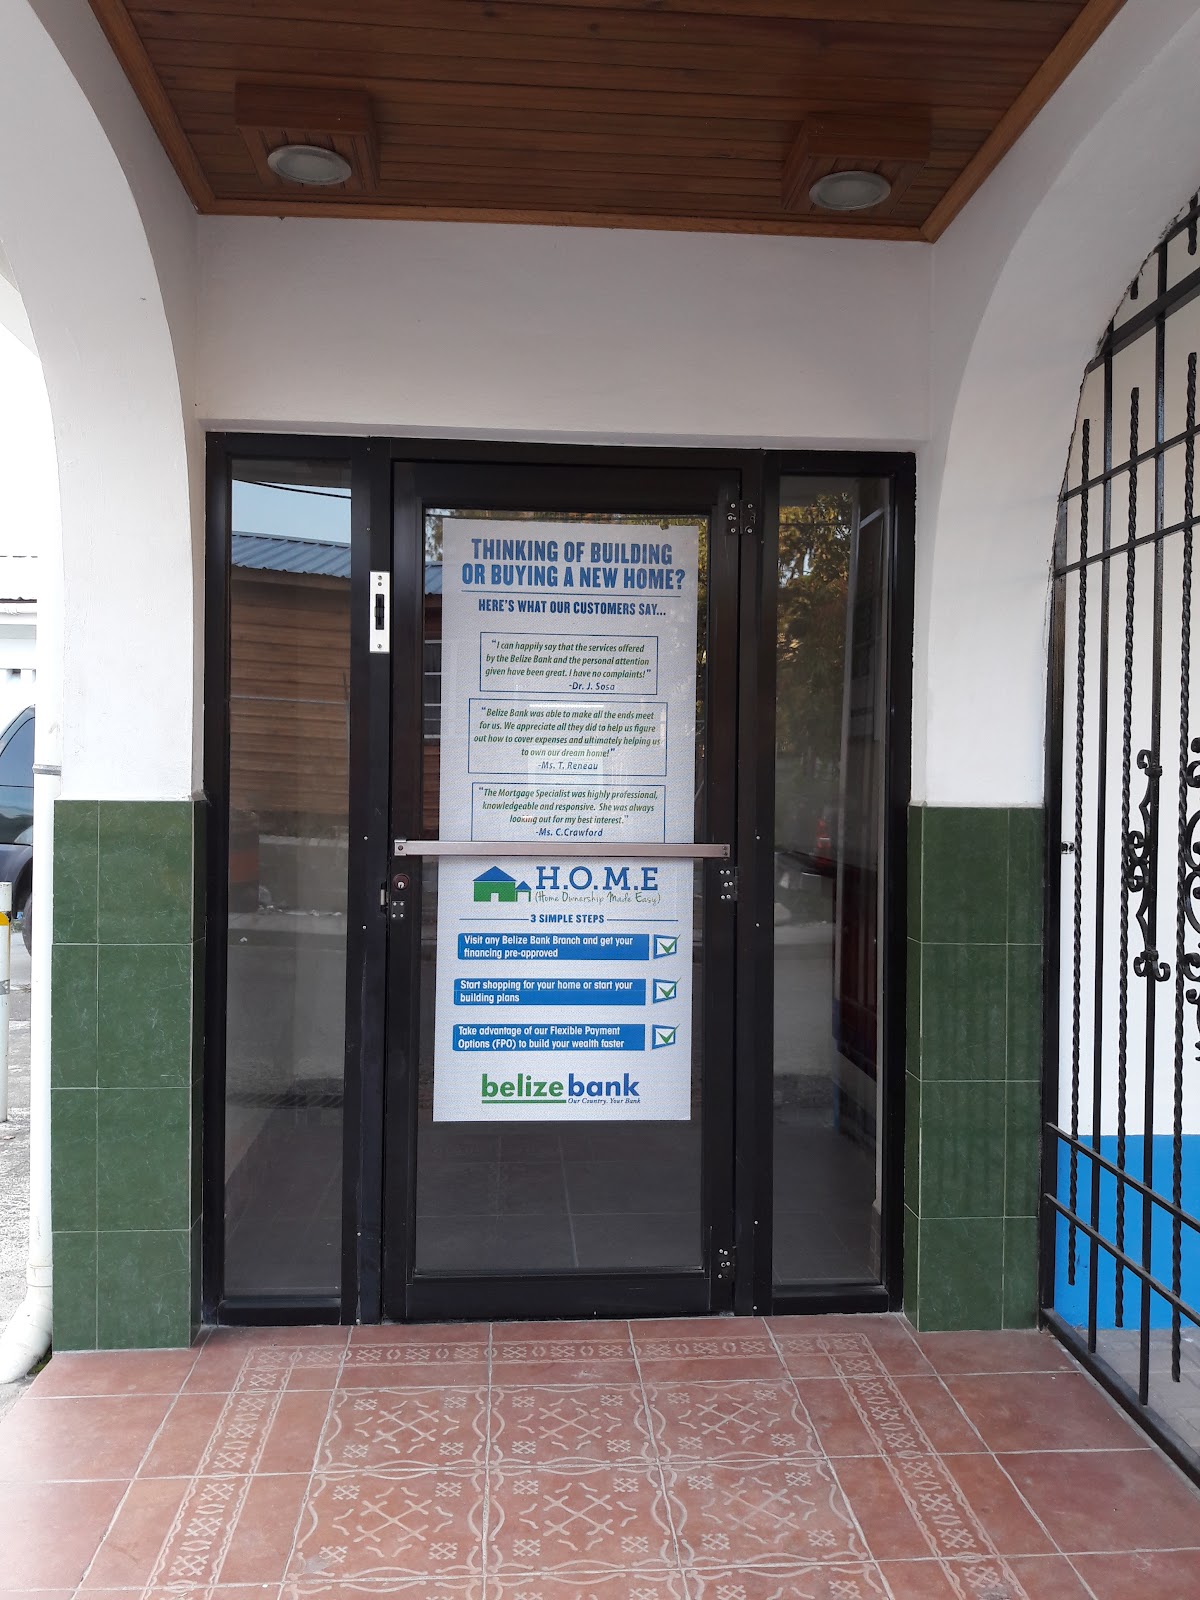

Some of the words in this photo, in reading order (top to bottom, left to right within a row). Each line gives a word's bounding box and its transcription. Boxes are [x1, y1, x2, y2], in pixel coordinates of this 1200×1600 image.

[472, 539, 558, 562] THINKING
[564, 541, 585, 562] OF
[591, 543, 672, 564] BUILDING
[462, 563, 485, 584] OR
[491, 564, 558, 586] BUYING
[564, 566, 574, 587] A
[580, 567, 618, 588] NEW
[624, 568, 685, 589] HOME?
[478, 599, 514, 611] HERE'S
[518, 600, 547, 613] WHAT
[550, 601, 570, 613] OUR
[574, 602, 635, 615] CUSTOMERS
[515, 642, 543, 652] happily
[544, 645, 556, 653] say
[618, 644, 644, 652] offered
[486, 654, 495, 663] by
[510, 655, 532, 663] Belize
[533, 655, 552, 663] Bank
[569, 656, 581, 664] the
[582, 657, 614, 666] personal
[485, 667, 505, 677] given
[526, 668, 544, 676] been
[546, 669, 567, 678] great.
[569, 682, 584, 690] -Dr.
[572, 710, 592, 718] make
[593, 710, 603, 718] all
[604, 710, 616, 719] the
[479, 721, 490, 731] for
[517, 722, 555, 733] appreciate
[568, 723, 584, 733] they
[607, 724, 623, 734] help
[634, 724, 656, 734] figure
[584, 736, 622, 746] ultimately
[623, 737, 650, 746] helping
[561, 749, 585, 757] dream
[538, 761, 555, 769] -Ms.
[498, 789, 534, 799] Mortgage
[536, 790, 570, 800] Specialist
[587, 790, 610, 800] highly
[611, 790, 658, 800] professional,
[482, 802, 538, 812] knowledgeable
[555, 804, 595, 813] responsive.
[629, 804, 654, 813] always
[510, 816, 537, 824] looking
[552, 815, 563, 824] for
[536, 866, 658, 891] H.O.M.E
[607, 891, 632, 903] Made
[636, 892, 661, 905] Easy)
[530, 915, 536, 923] 3
[540, 914, 573, 923] SIMPLE
[576, 914, 604, 923] STEPS
[464, 935, 483, 944] Visit
[485, 938, 499, 946] any
[502, 936, 527, 945] Belize
[530, 936, 550, 945] Bank
[553, 936, 580, 945] Branch
[583, 936, 598, 945] and
[600, 937, 613, 947] get
[615, 938, 633, 947] your
[464, 948, 502, 958] financing
[505, 949, 558, 959] pre-approved
[460, 980, 480, 989] Start
[483, 980, 521, 991] shopping
[523, 980, 535, 989] for
[537, 982, 555, 992] your
[558, 981, 580, 989] home
[594, 981, 612, 990] start
[615, 983, 633, 992] your
[460, 993, 494, 1004] building
[497, 993, 520, 1004] plans
[459, 1026, 477, 1035] Take
[479, 1027, 521, 1038] advantage
[524, 1026, 532, 1035] of
[550, 1027, 582, 1035] Flexible
[585, 1027, 620, 1038] Payment
[458, 1039, 490, 1050] Options
[492, 1039, 516, 1050] (FPO)
[519, 1040, 526, 1048] to
[529, 1039, 549, 1048] build
[552, 1041, 570, 1050] your
[572, 1039, 599, 1048] wealth
[601, 1039, 624, 1048] faster
[482, 1073, 564, 1097] belize
[568, 1073, 639, 1097] bank
